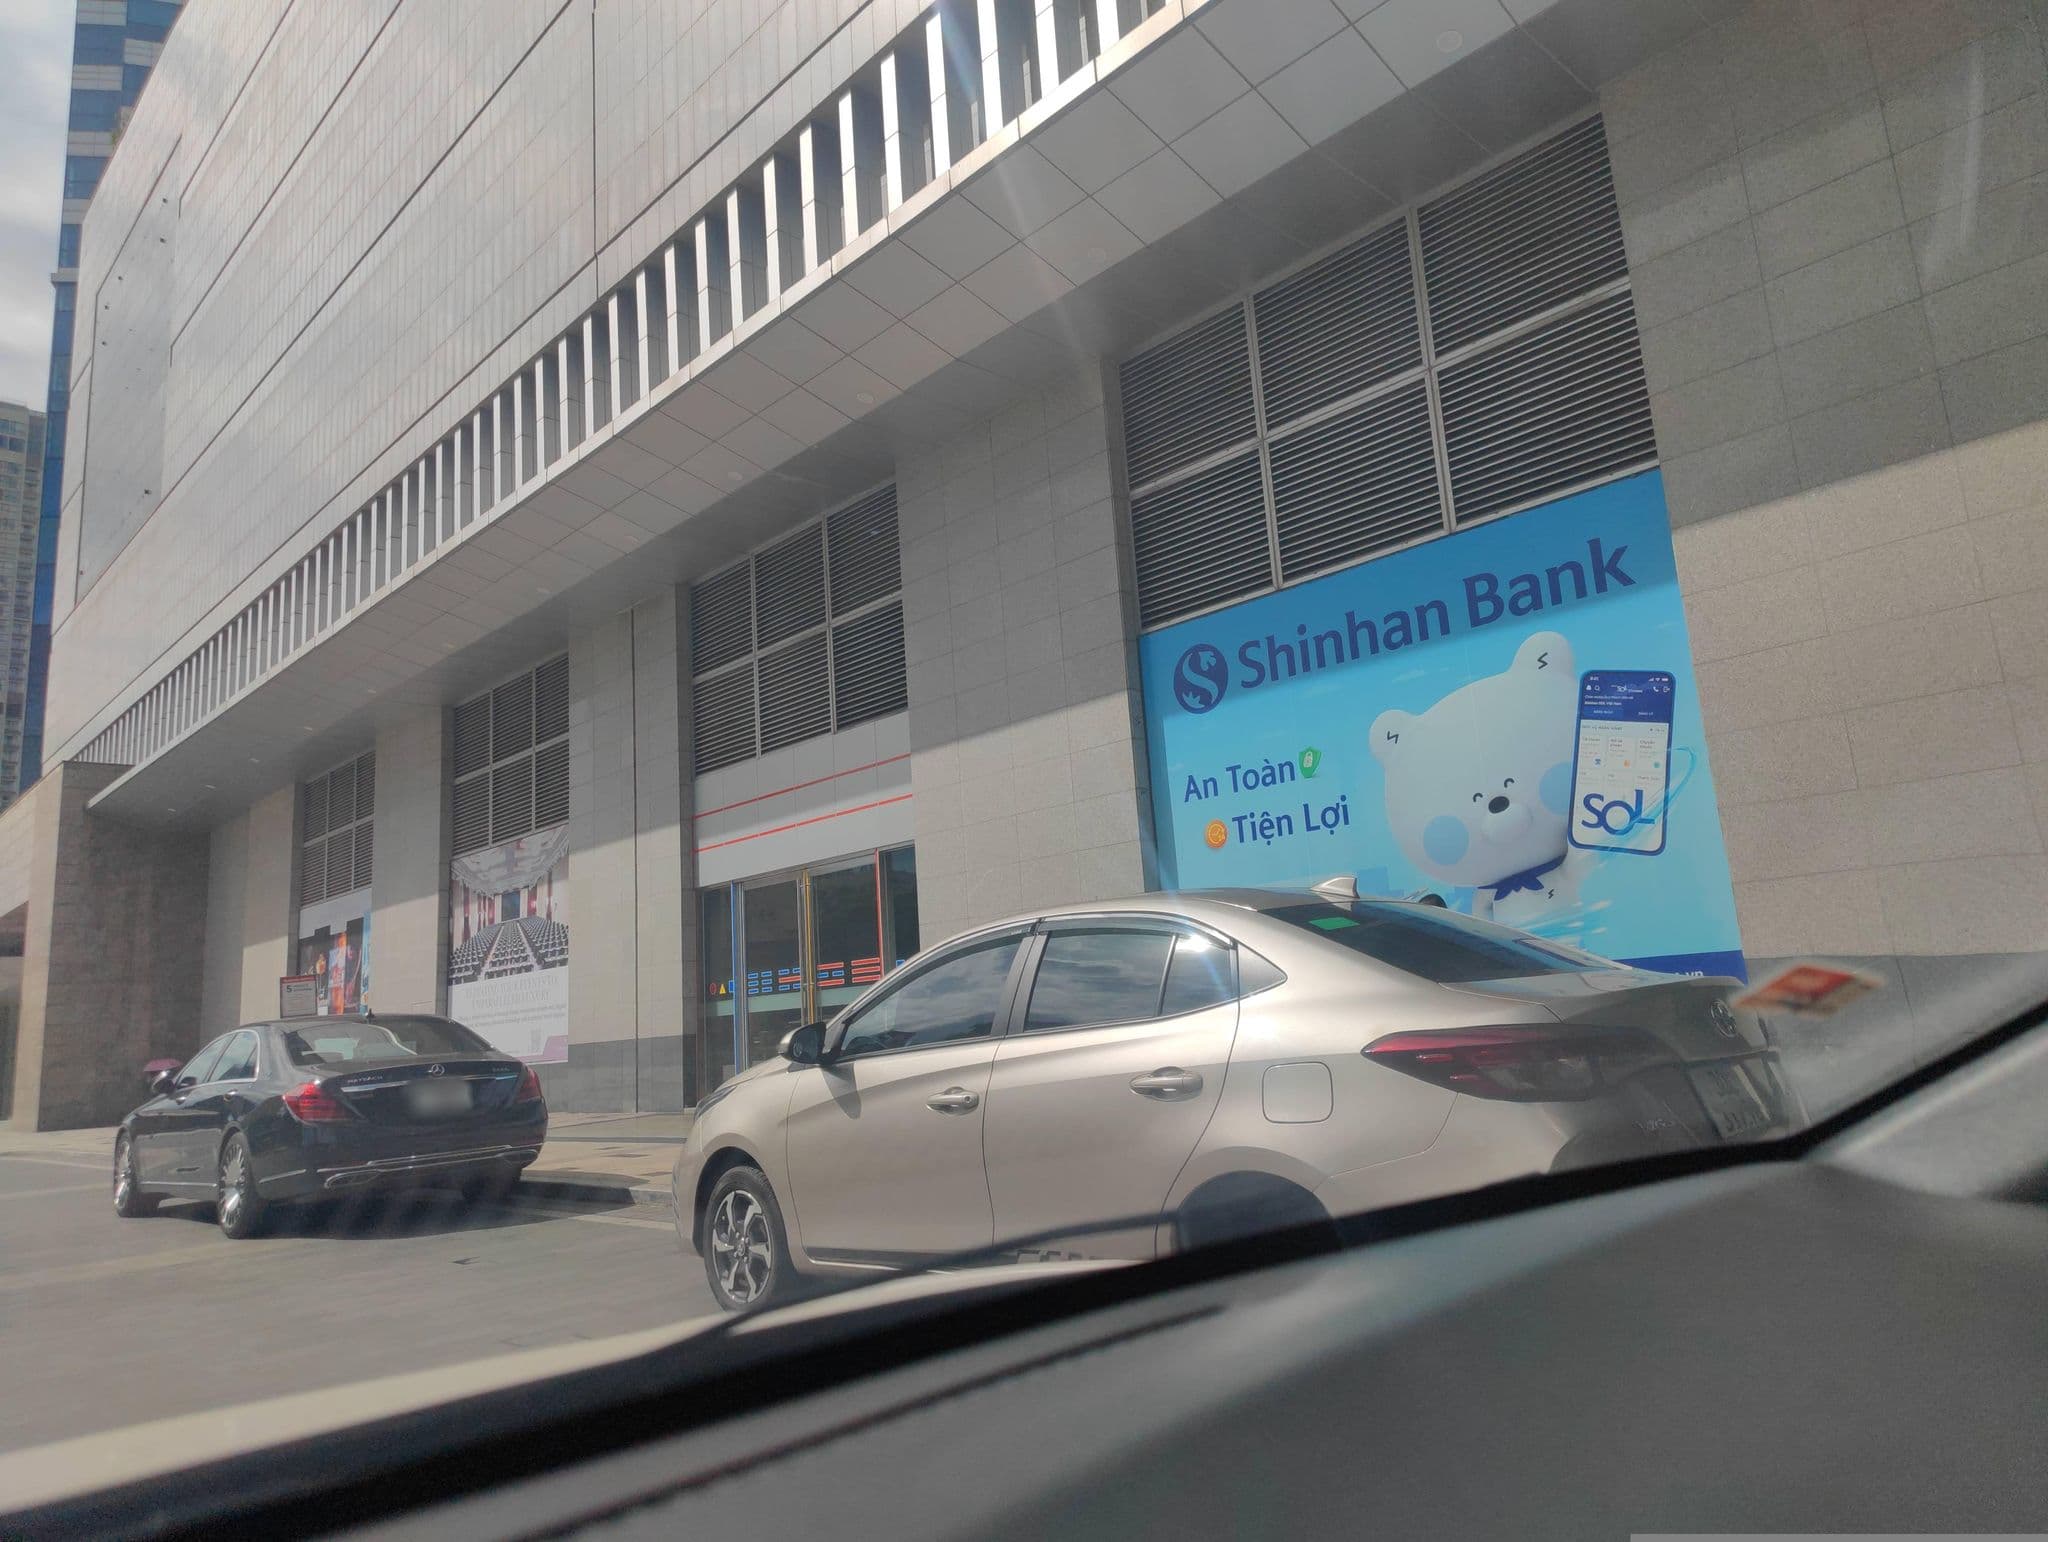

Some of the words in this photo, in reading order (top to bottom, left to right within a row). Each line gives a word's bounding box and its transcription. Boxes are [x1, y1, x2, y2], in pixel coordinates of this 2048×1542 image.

[1238, 599, 1451, 689] Shinhan
[1462, 537, 1637, 629] Bank
[1184, 774, 1219, 803] An
[1225, 758, 1296, 794] Toàn
[1231, 811, 1294, 846] Tiện
[1302, 794, 1350, 835] Lợi
